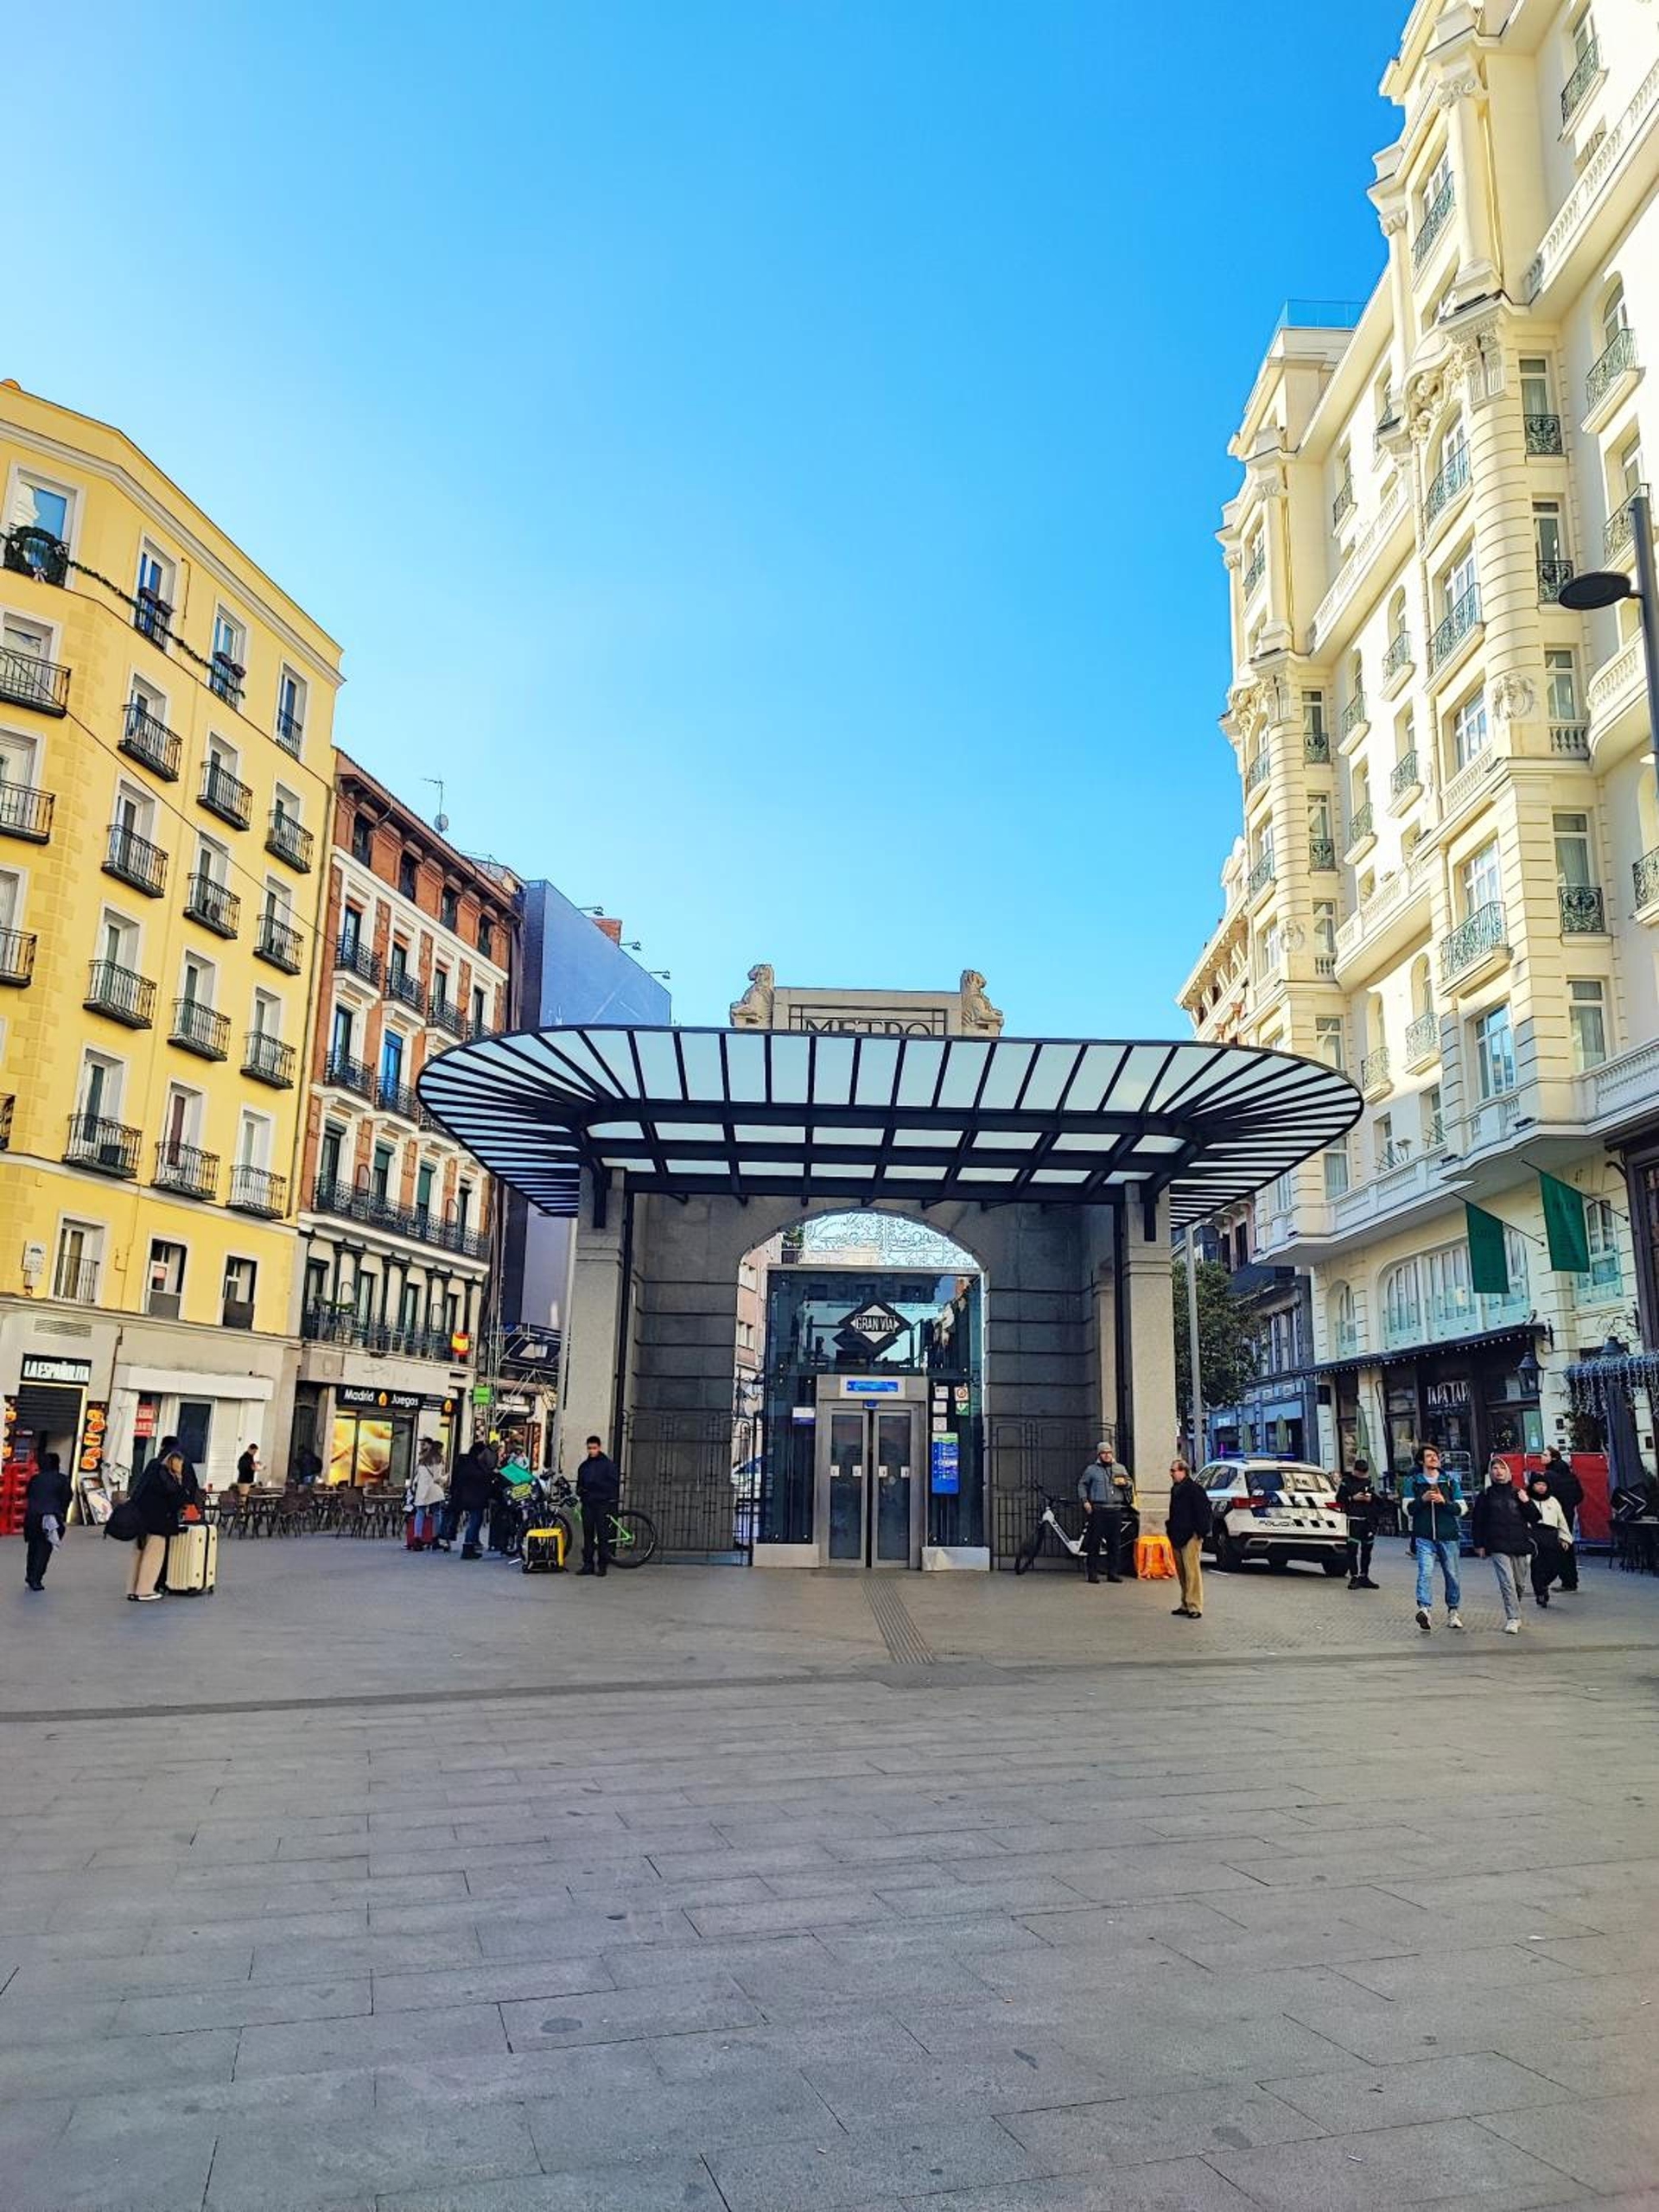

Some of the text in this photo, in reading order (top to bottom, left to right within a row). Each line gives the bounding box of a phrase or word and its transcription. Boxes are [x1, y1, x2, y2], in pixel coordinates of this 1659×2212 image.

[855, 1316, 879, 1331] GRAN
[344, 1389, 418, 1408] Madrid Juegos
